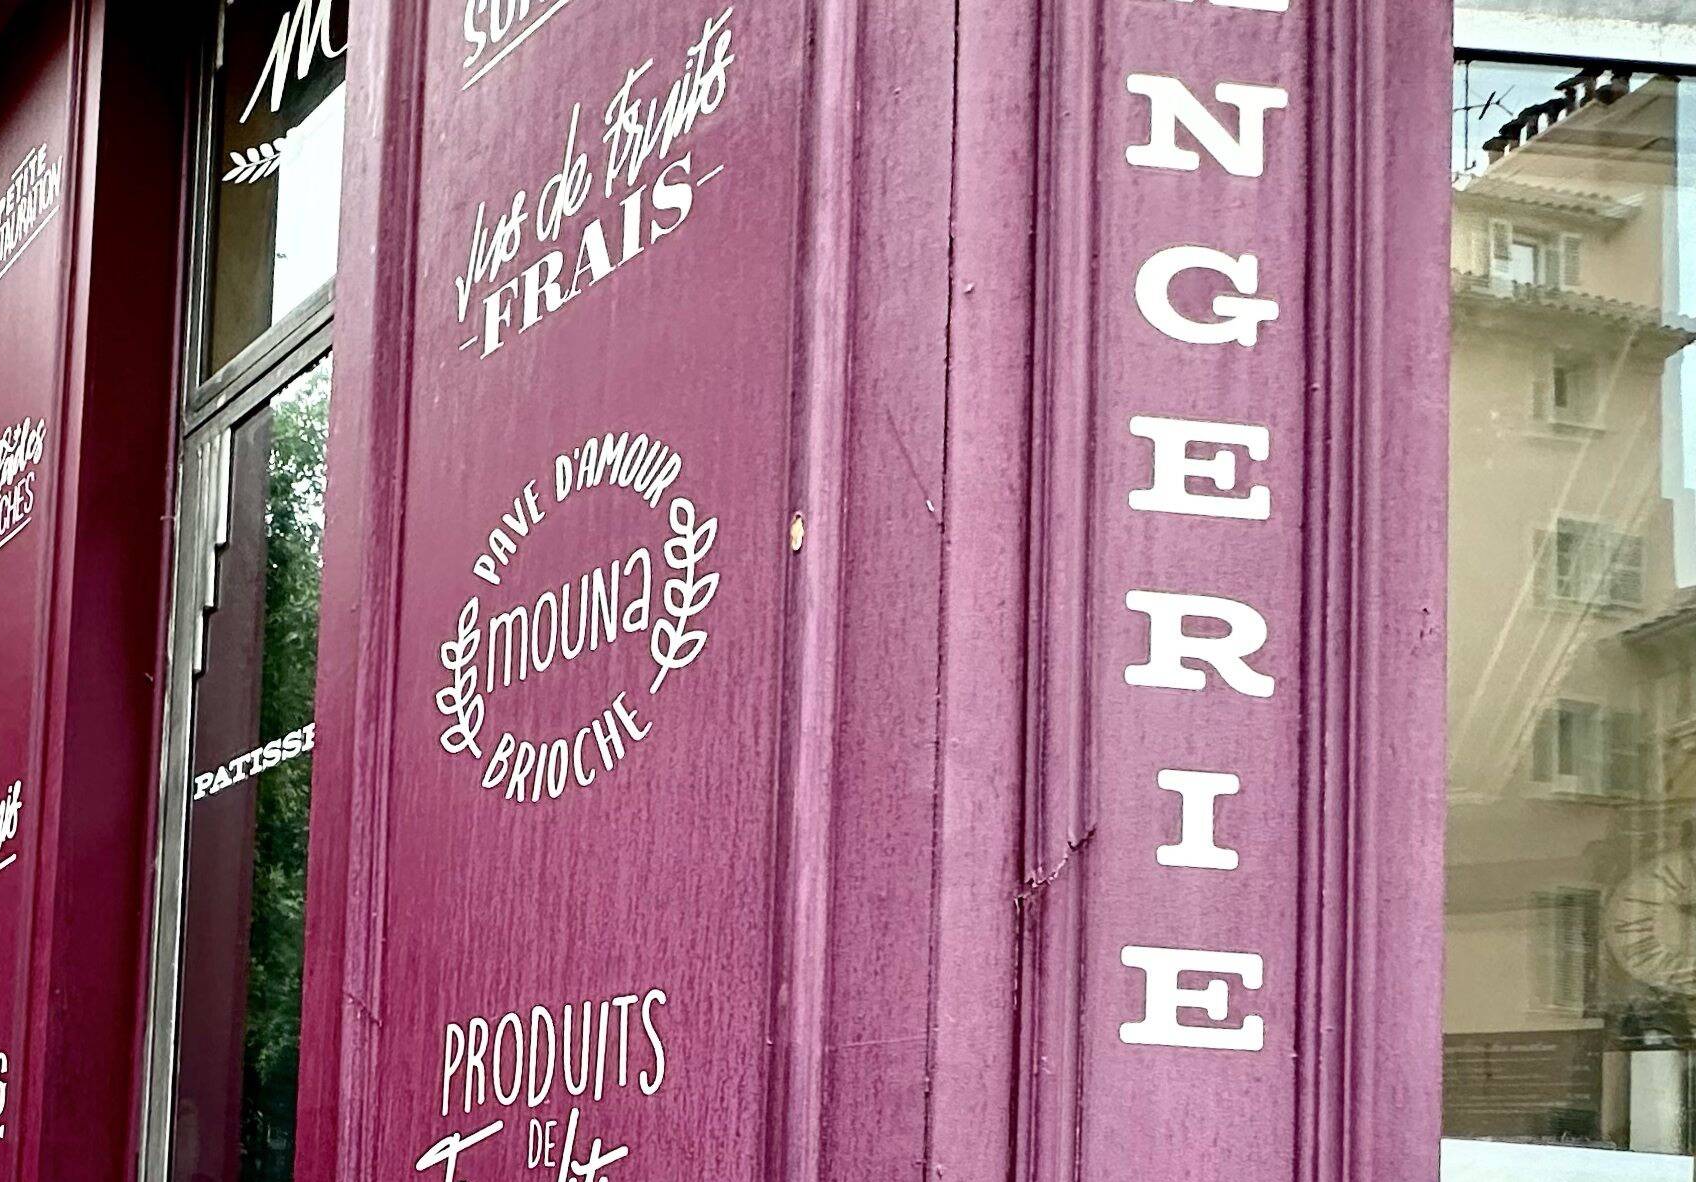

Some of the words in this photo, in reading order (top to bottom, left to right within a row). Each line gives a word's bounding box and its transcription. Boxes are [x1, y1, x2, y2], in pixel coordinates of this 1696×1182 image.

[455, 190, 528, 323] Jus
[536, 102, 592, 242] de
[603, 6, 735, 199] fruits
[554, 431, 683, 509] D'AMOUR
[1117, 0, 1289, 1053] NGERIE
[481, 690, 653, 802] BRIOCHE
[441, 988, 667, 1117] PRODUITS
[527, 1117, 557, 1169] DE
